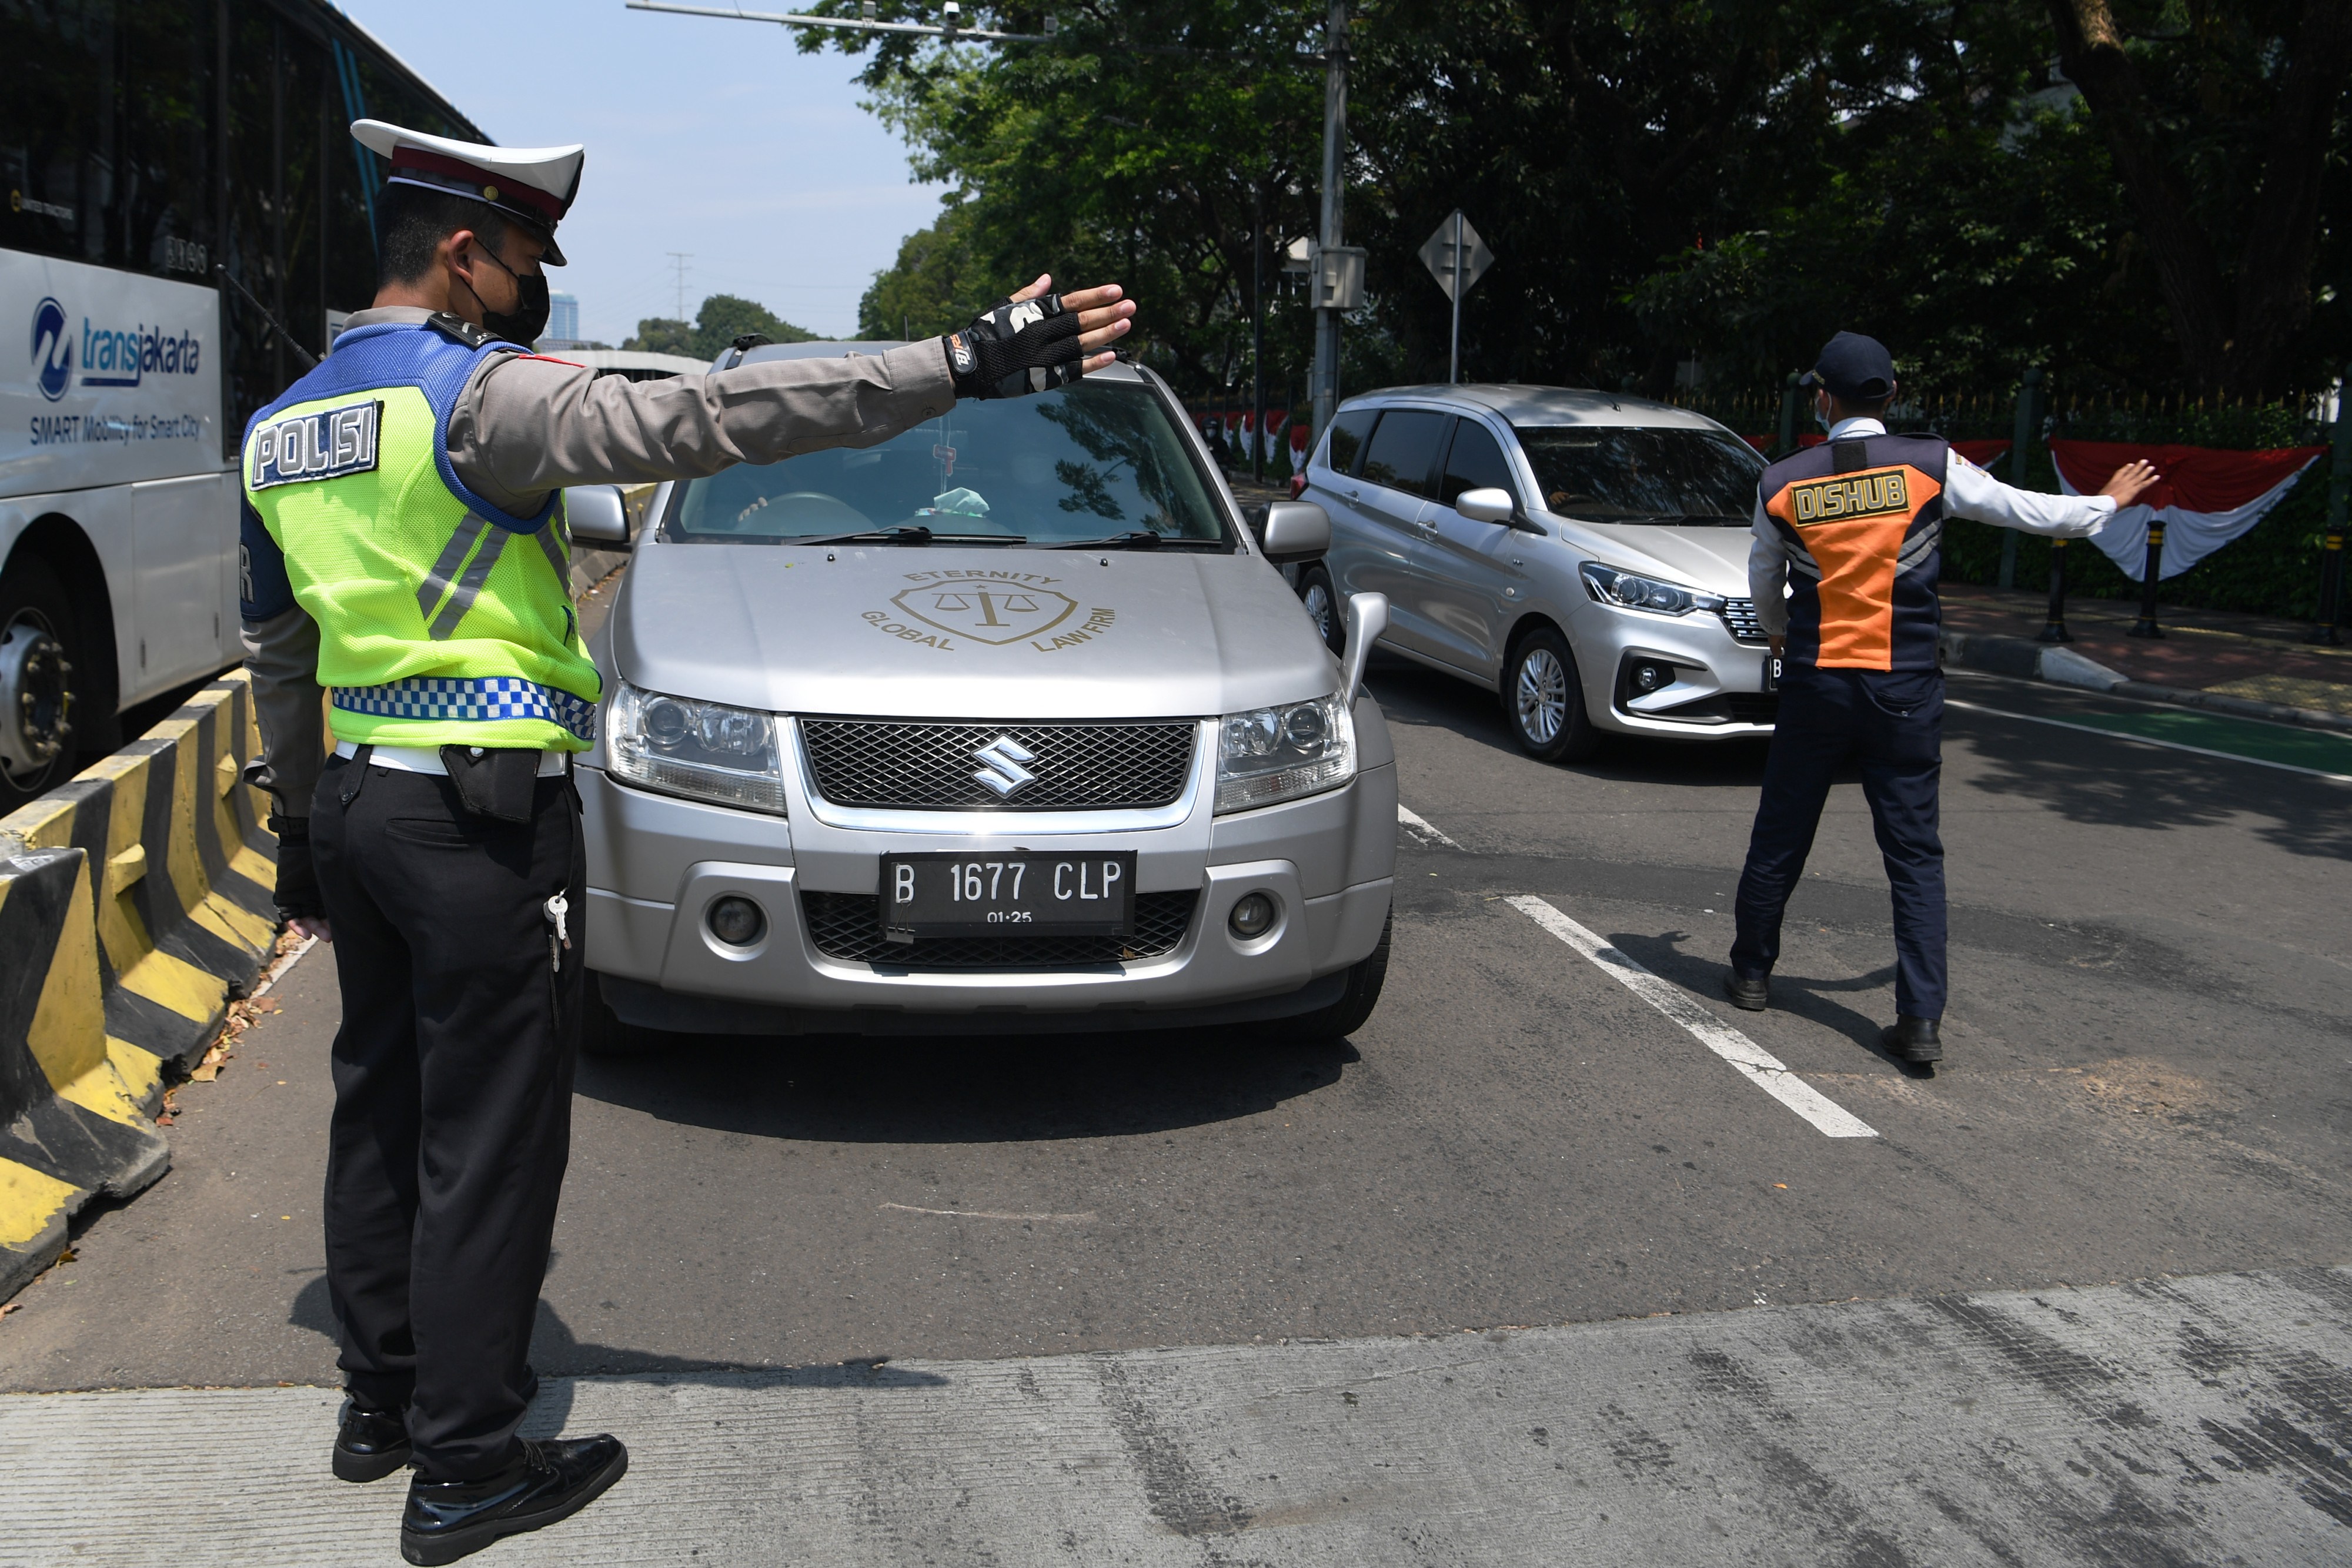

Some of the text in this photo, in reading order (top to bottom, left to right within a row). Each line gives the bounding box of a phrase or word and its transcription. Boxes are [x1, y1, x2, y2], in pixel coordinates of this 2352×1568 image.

[81, 316, 200, 386] transjakarta
[31, 414, 200, 445] SMART Mobility for Smart City
[253, 405, 375, 484] POLISI
[1796, 475, 1906, 520] DISHUB
[902, 570, 1063, 584] ETERNITY
[861, 611, 955, 651] GLOBAL
[1030, 607, 1115, 652] LAW FIRM
[1773, 658, 1782, 678] B
[895, 861, 1121, 904] B 1677 CLP
